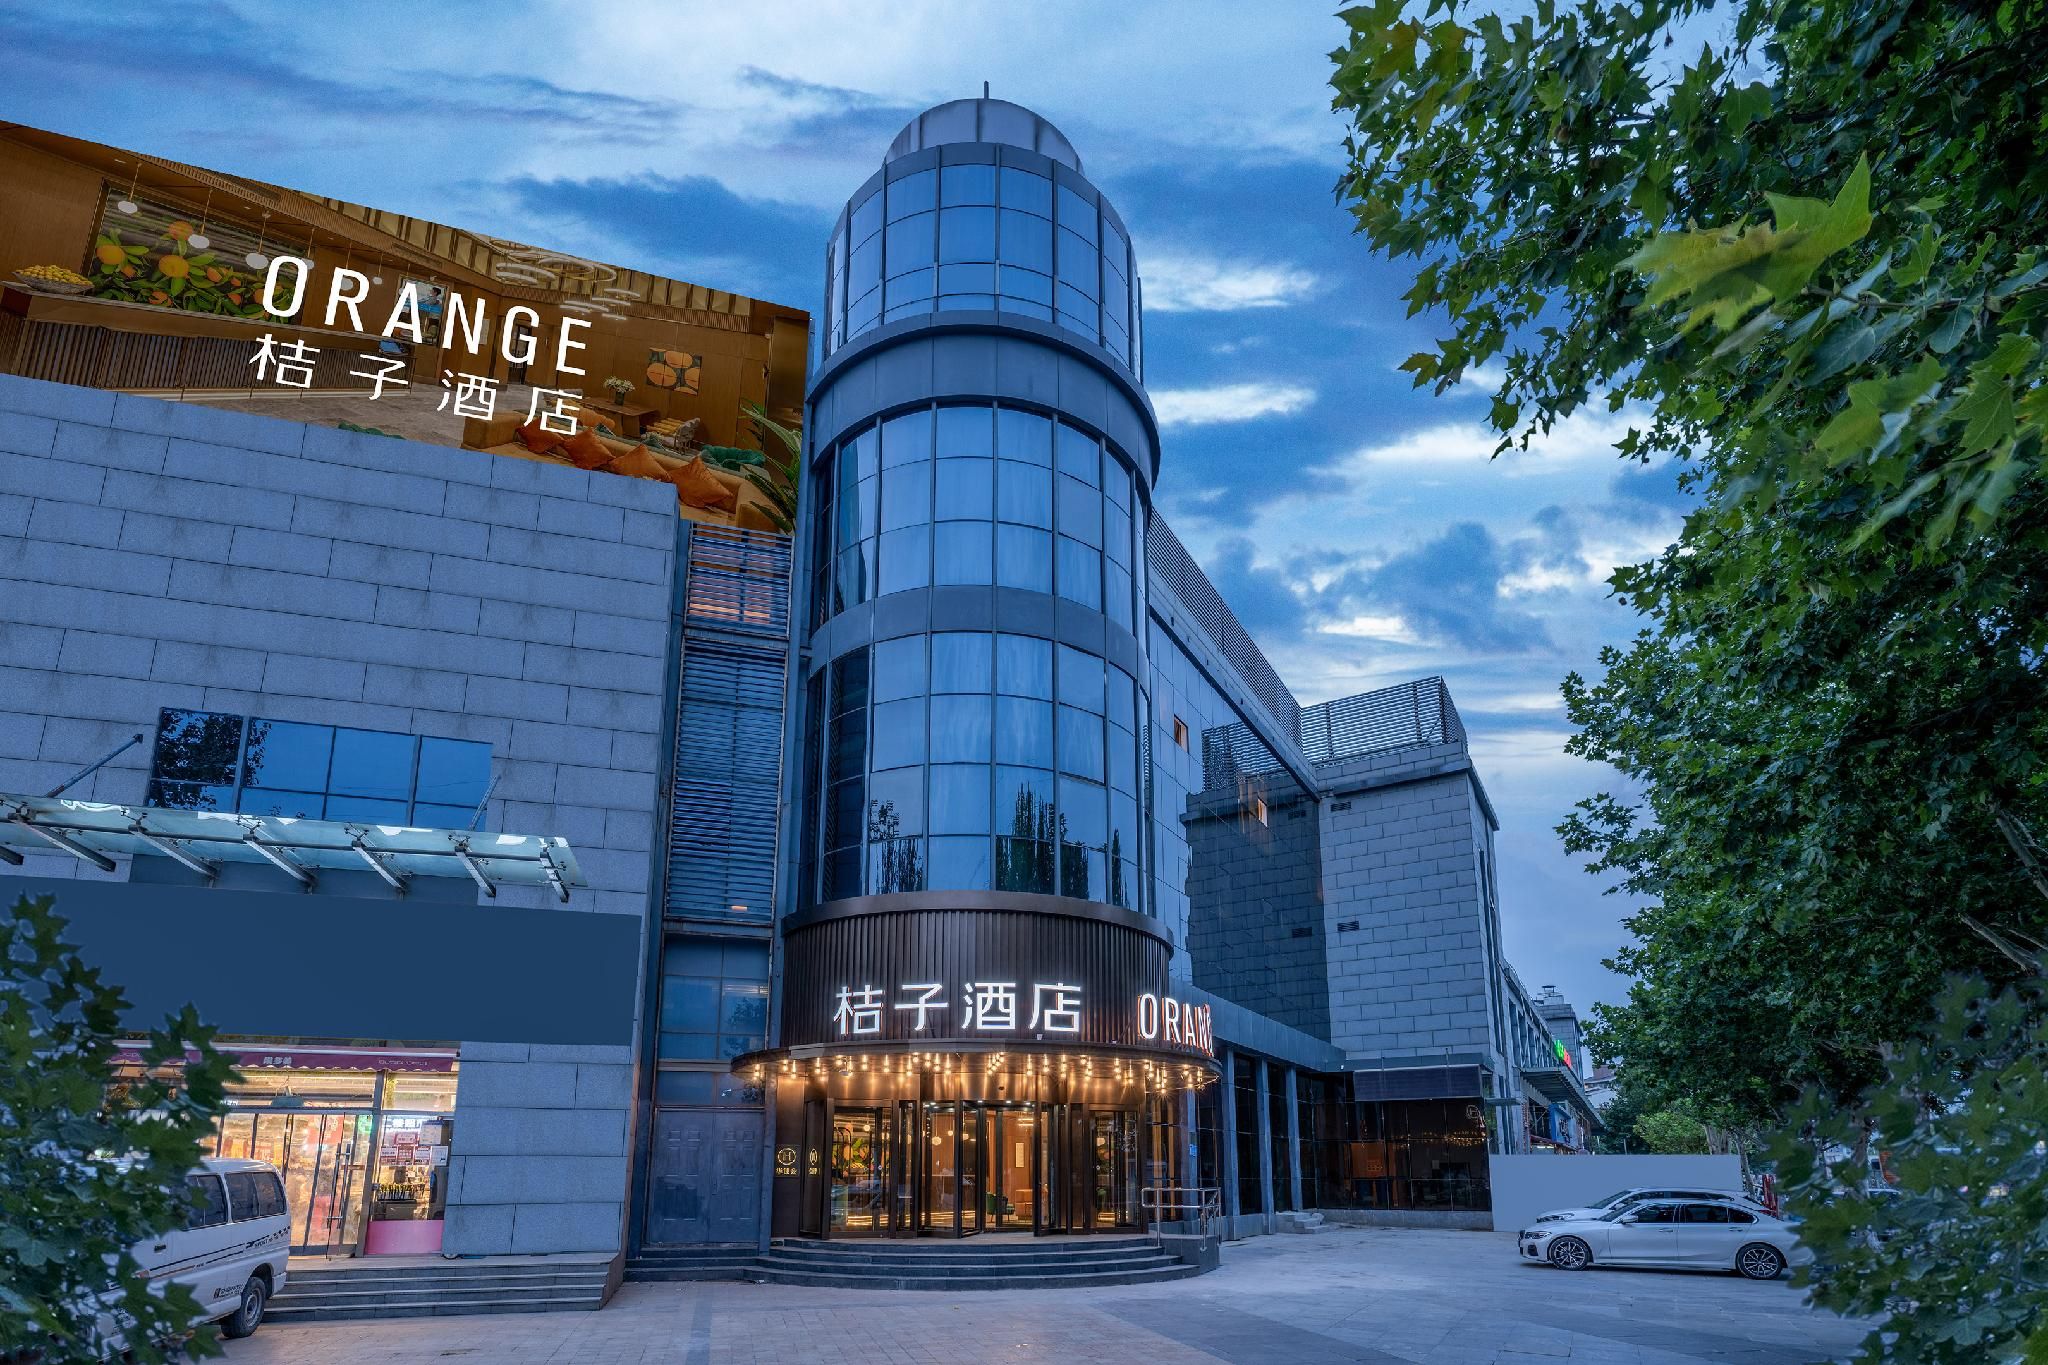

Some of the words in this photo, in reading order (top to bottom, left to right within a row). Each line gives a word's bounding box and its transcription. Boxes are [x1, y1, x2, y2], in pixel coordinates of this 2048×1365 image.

[262, 255, 592, 376] ORANGE
[249, 333, 583, 437] 桔子酒店
[834, 982, 1081, 1034] 桔子酒店
